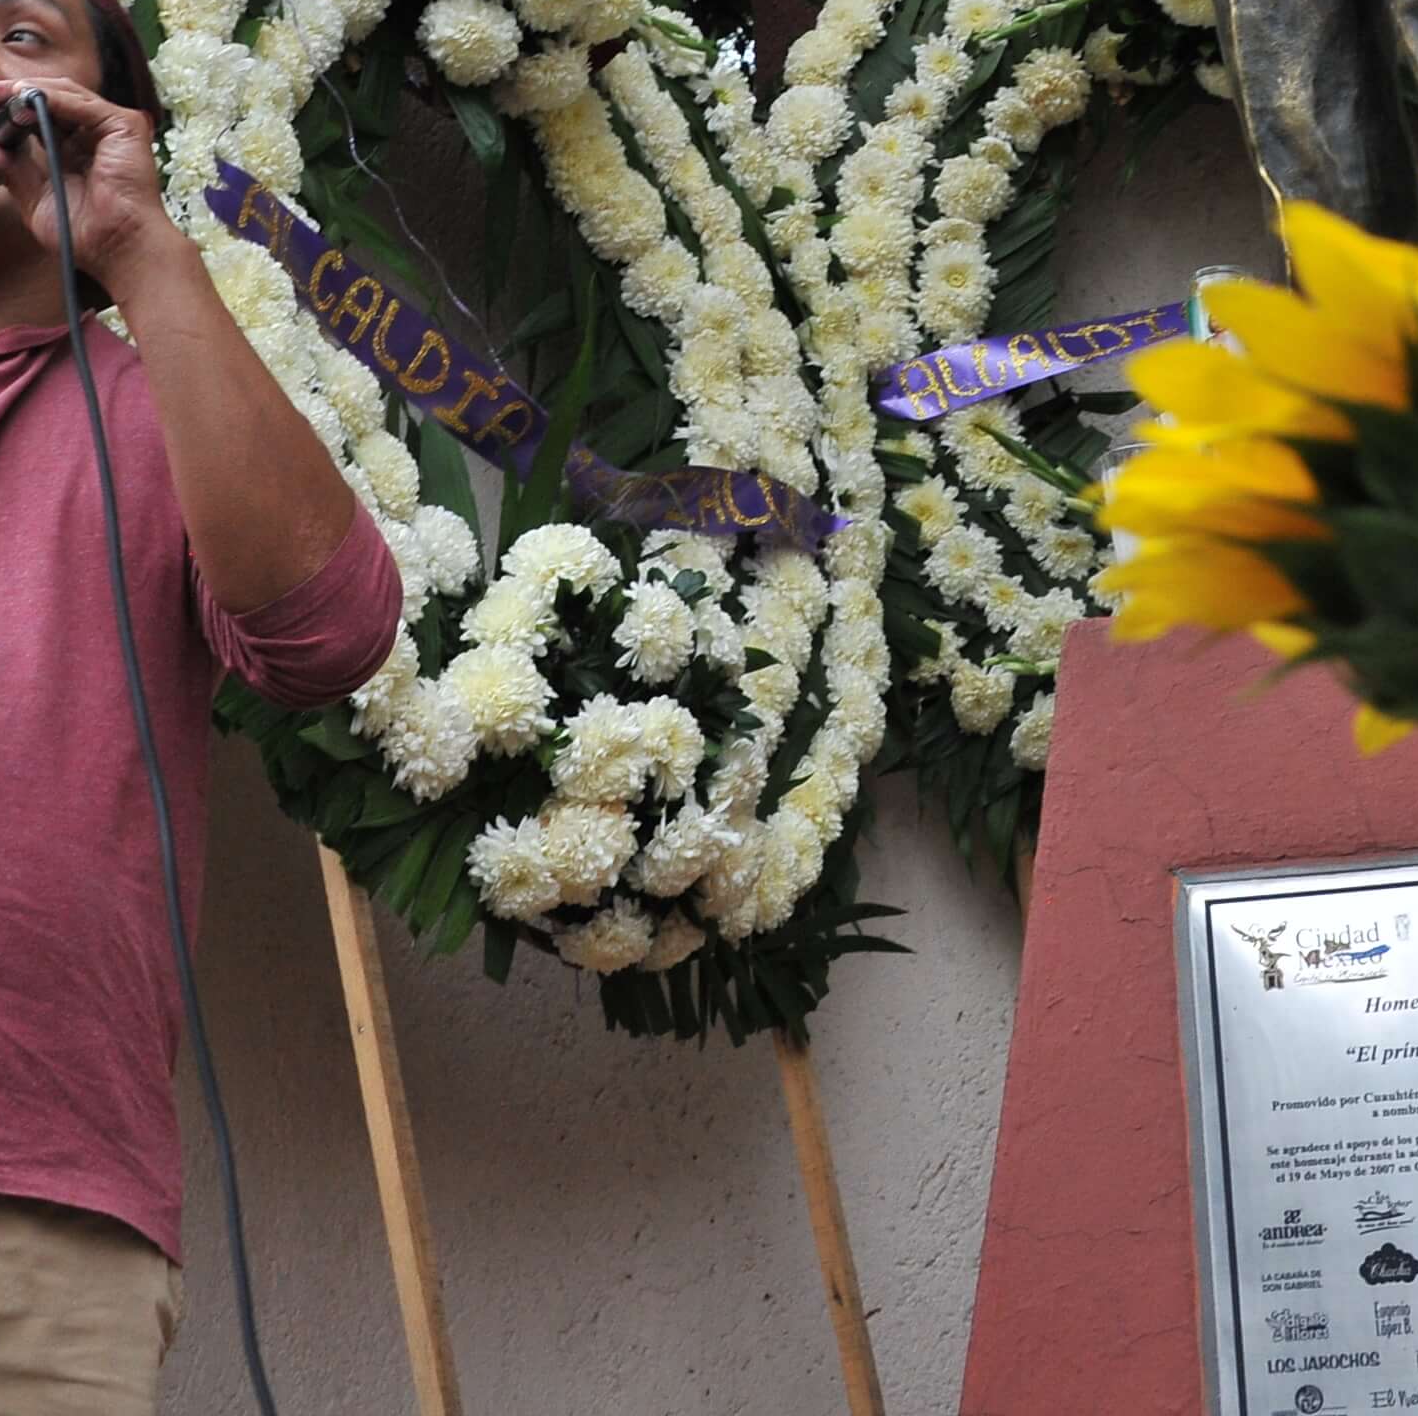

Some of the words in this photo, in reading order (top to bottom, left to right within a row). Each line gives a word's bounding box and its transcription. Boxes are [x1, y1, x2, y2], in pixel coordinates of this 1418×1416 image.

[1295, 921, 1380, 949] Ciudad
[1272, 1096, 1337, 1112] Promovido
[1340, 1096, 1360, 1109] por
[1372, 1109, 1379, 1118] a
[1267, 1145, 1280, 1156] Se
[1282, 1141, 1330, 1158] agradece
[1333, 1139, 1344, 1151] el
[1346, 1139, 1379, 1153] apoyo
[1381, 1135, 1395, 1147] de
[1397, 1134, 1413, 1146] los
[1270, 1159, 1291, 1171] este
[1294, 1154, 1346, 1170] homenaje
[1349, 1151, 1393, 1164] durante
[1395, 1148, 1406, 1160] la
[1275, 1173, 1286, 1184] el
[1288, 1171, 1301, 1183] 19
[1304, 1170, 1317, 1182] de
[1319, 1167, 1351, 1181] Mayo
[1354, 1165, 1368, 1177] de
[1369, 1163, 1396, 1176] 2007
[1398, 1163, 1412, 1173] en
[1262, 1283, 1282, 1293] DON
[1267, 1358, 1296, 1374] LOS
[1298, 1351, 1382, 1372] JAROCHOS
[1368, 1388, 1396, 1409] El
